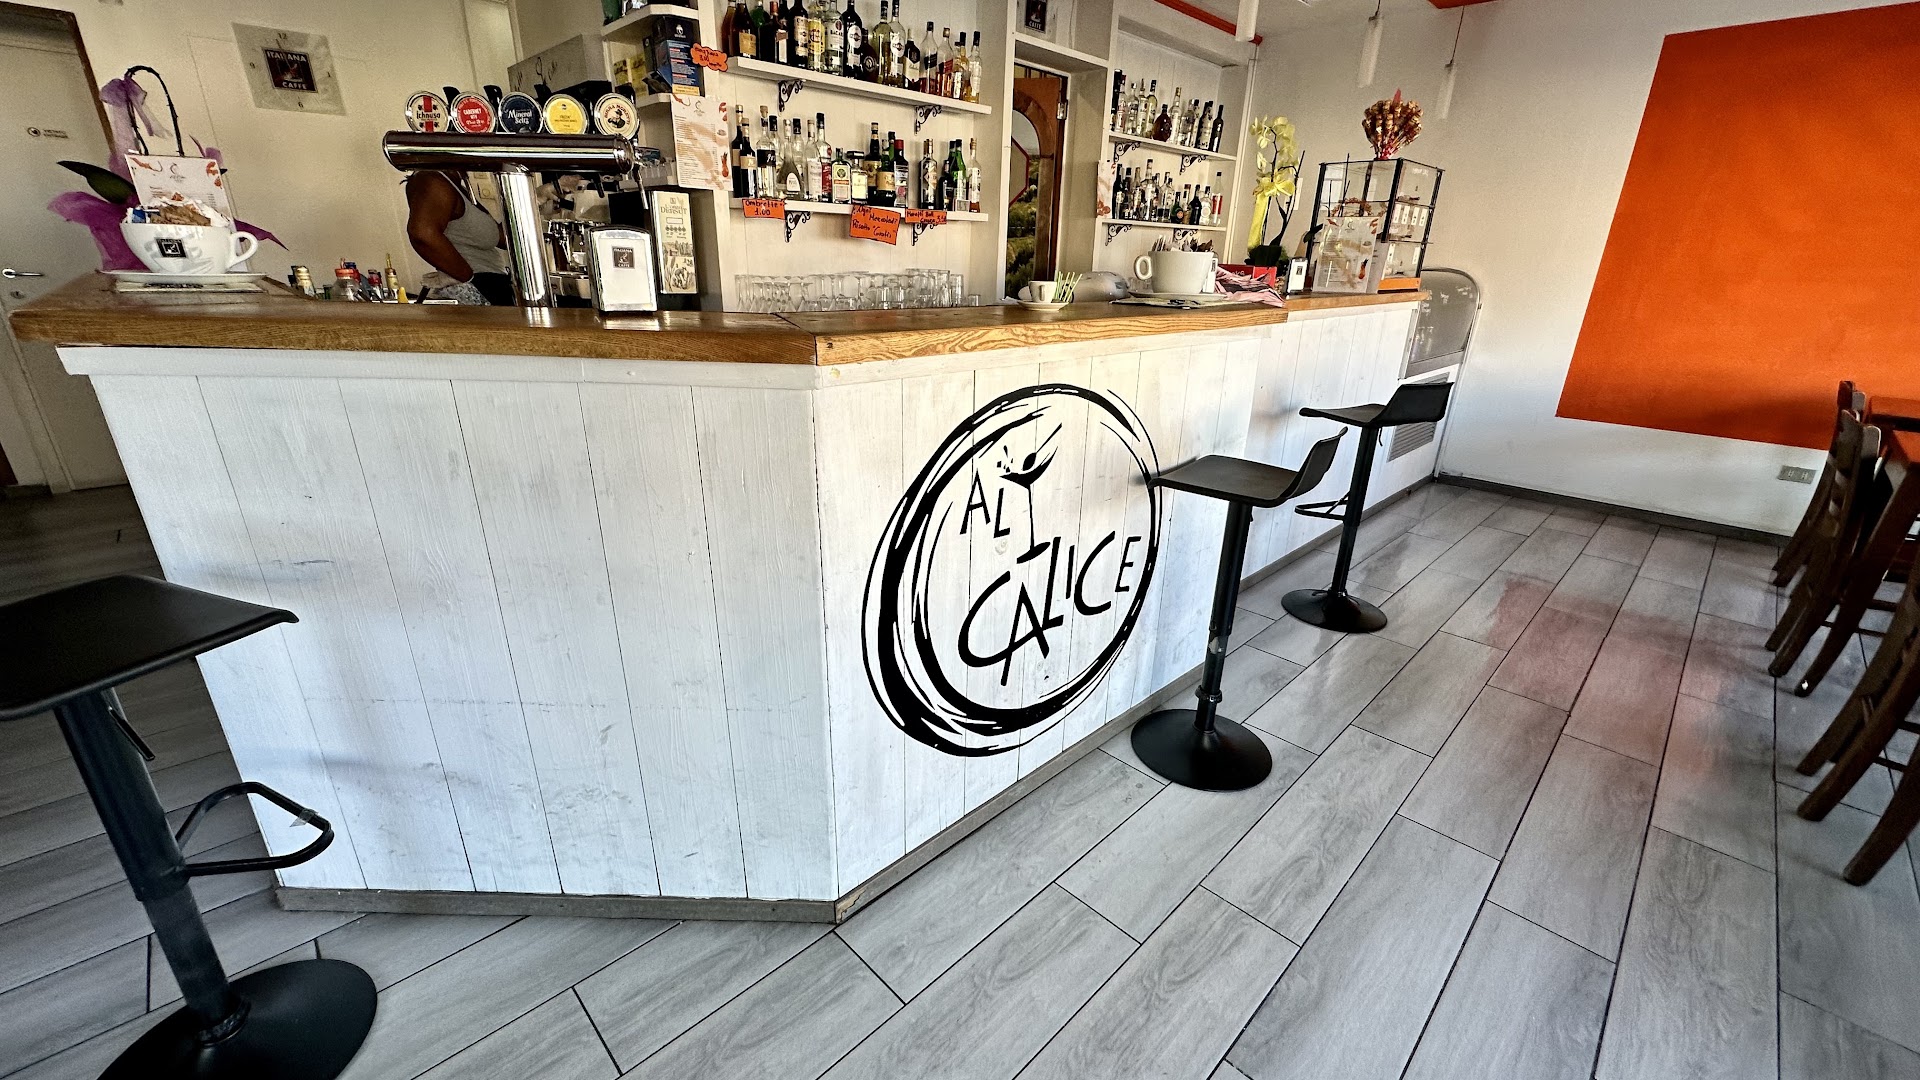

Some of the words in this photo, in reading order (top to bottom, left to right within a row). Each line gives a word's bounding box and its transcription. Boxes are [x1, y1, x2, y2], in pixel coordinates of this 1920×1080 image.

[278, 32, 288, 40] 12
[960, 468, 1011, 538] AL
[958, 531, 1142, 687] CALICE
